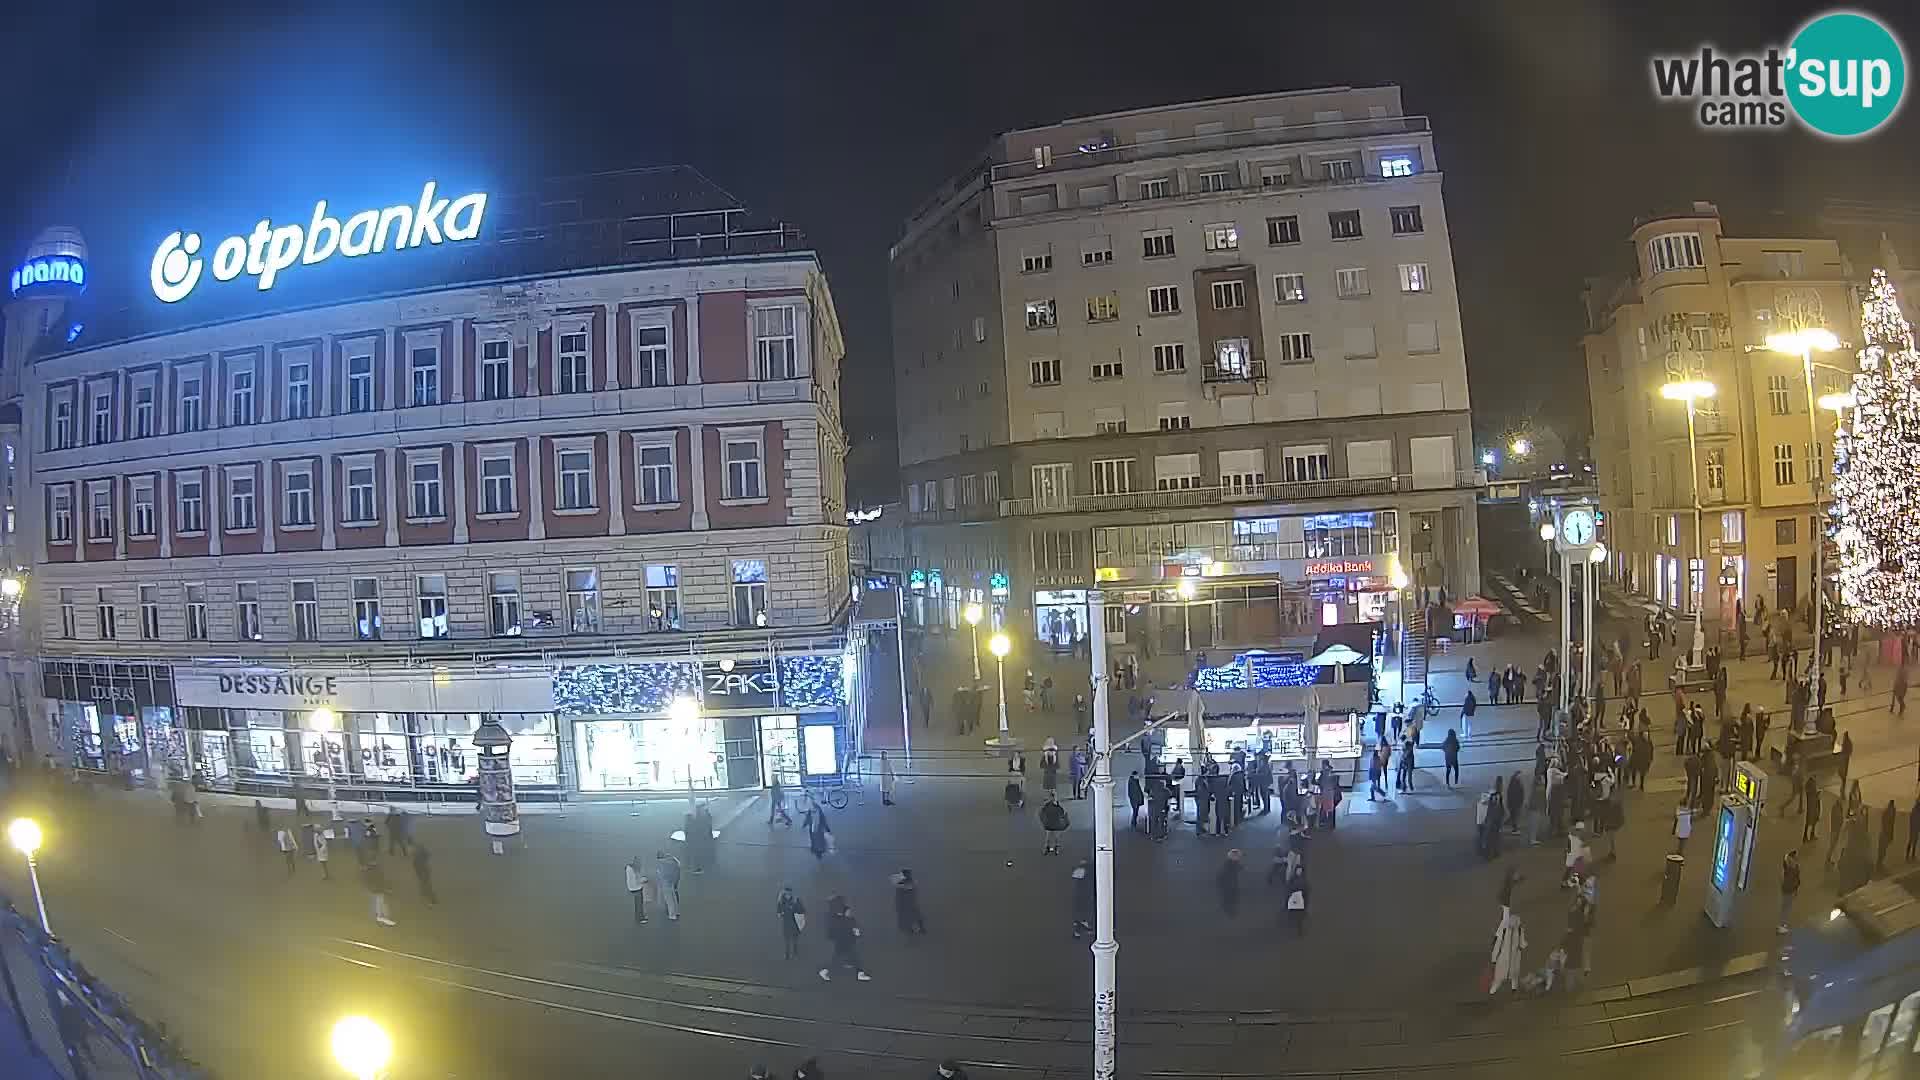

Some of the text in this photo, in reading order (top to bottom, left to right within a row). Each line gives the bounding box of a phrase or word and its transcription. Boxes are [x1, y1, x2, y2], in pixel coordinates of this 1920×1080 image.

[1343, 560, 1373, 573] Bank
[218, 674, 338, 695] DESSANGE
[705, 672, 780, 696] ZAKS
